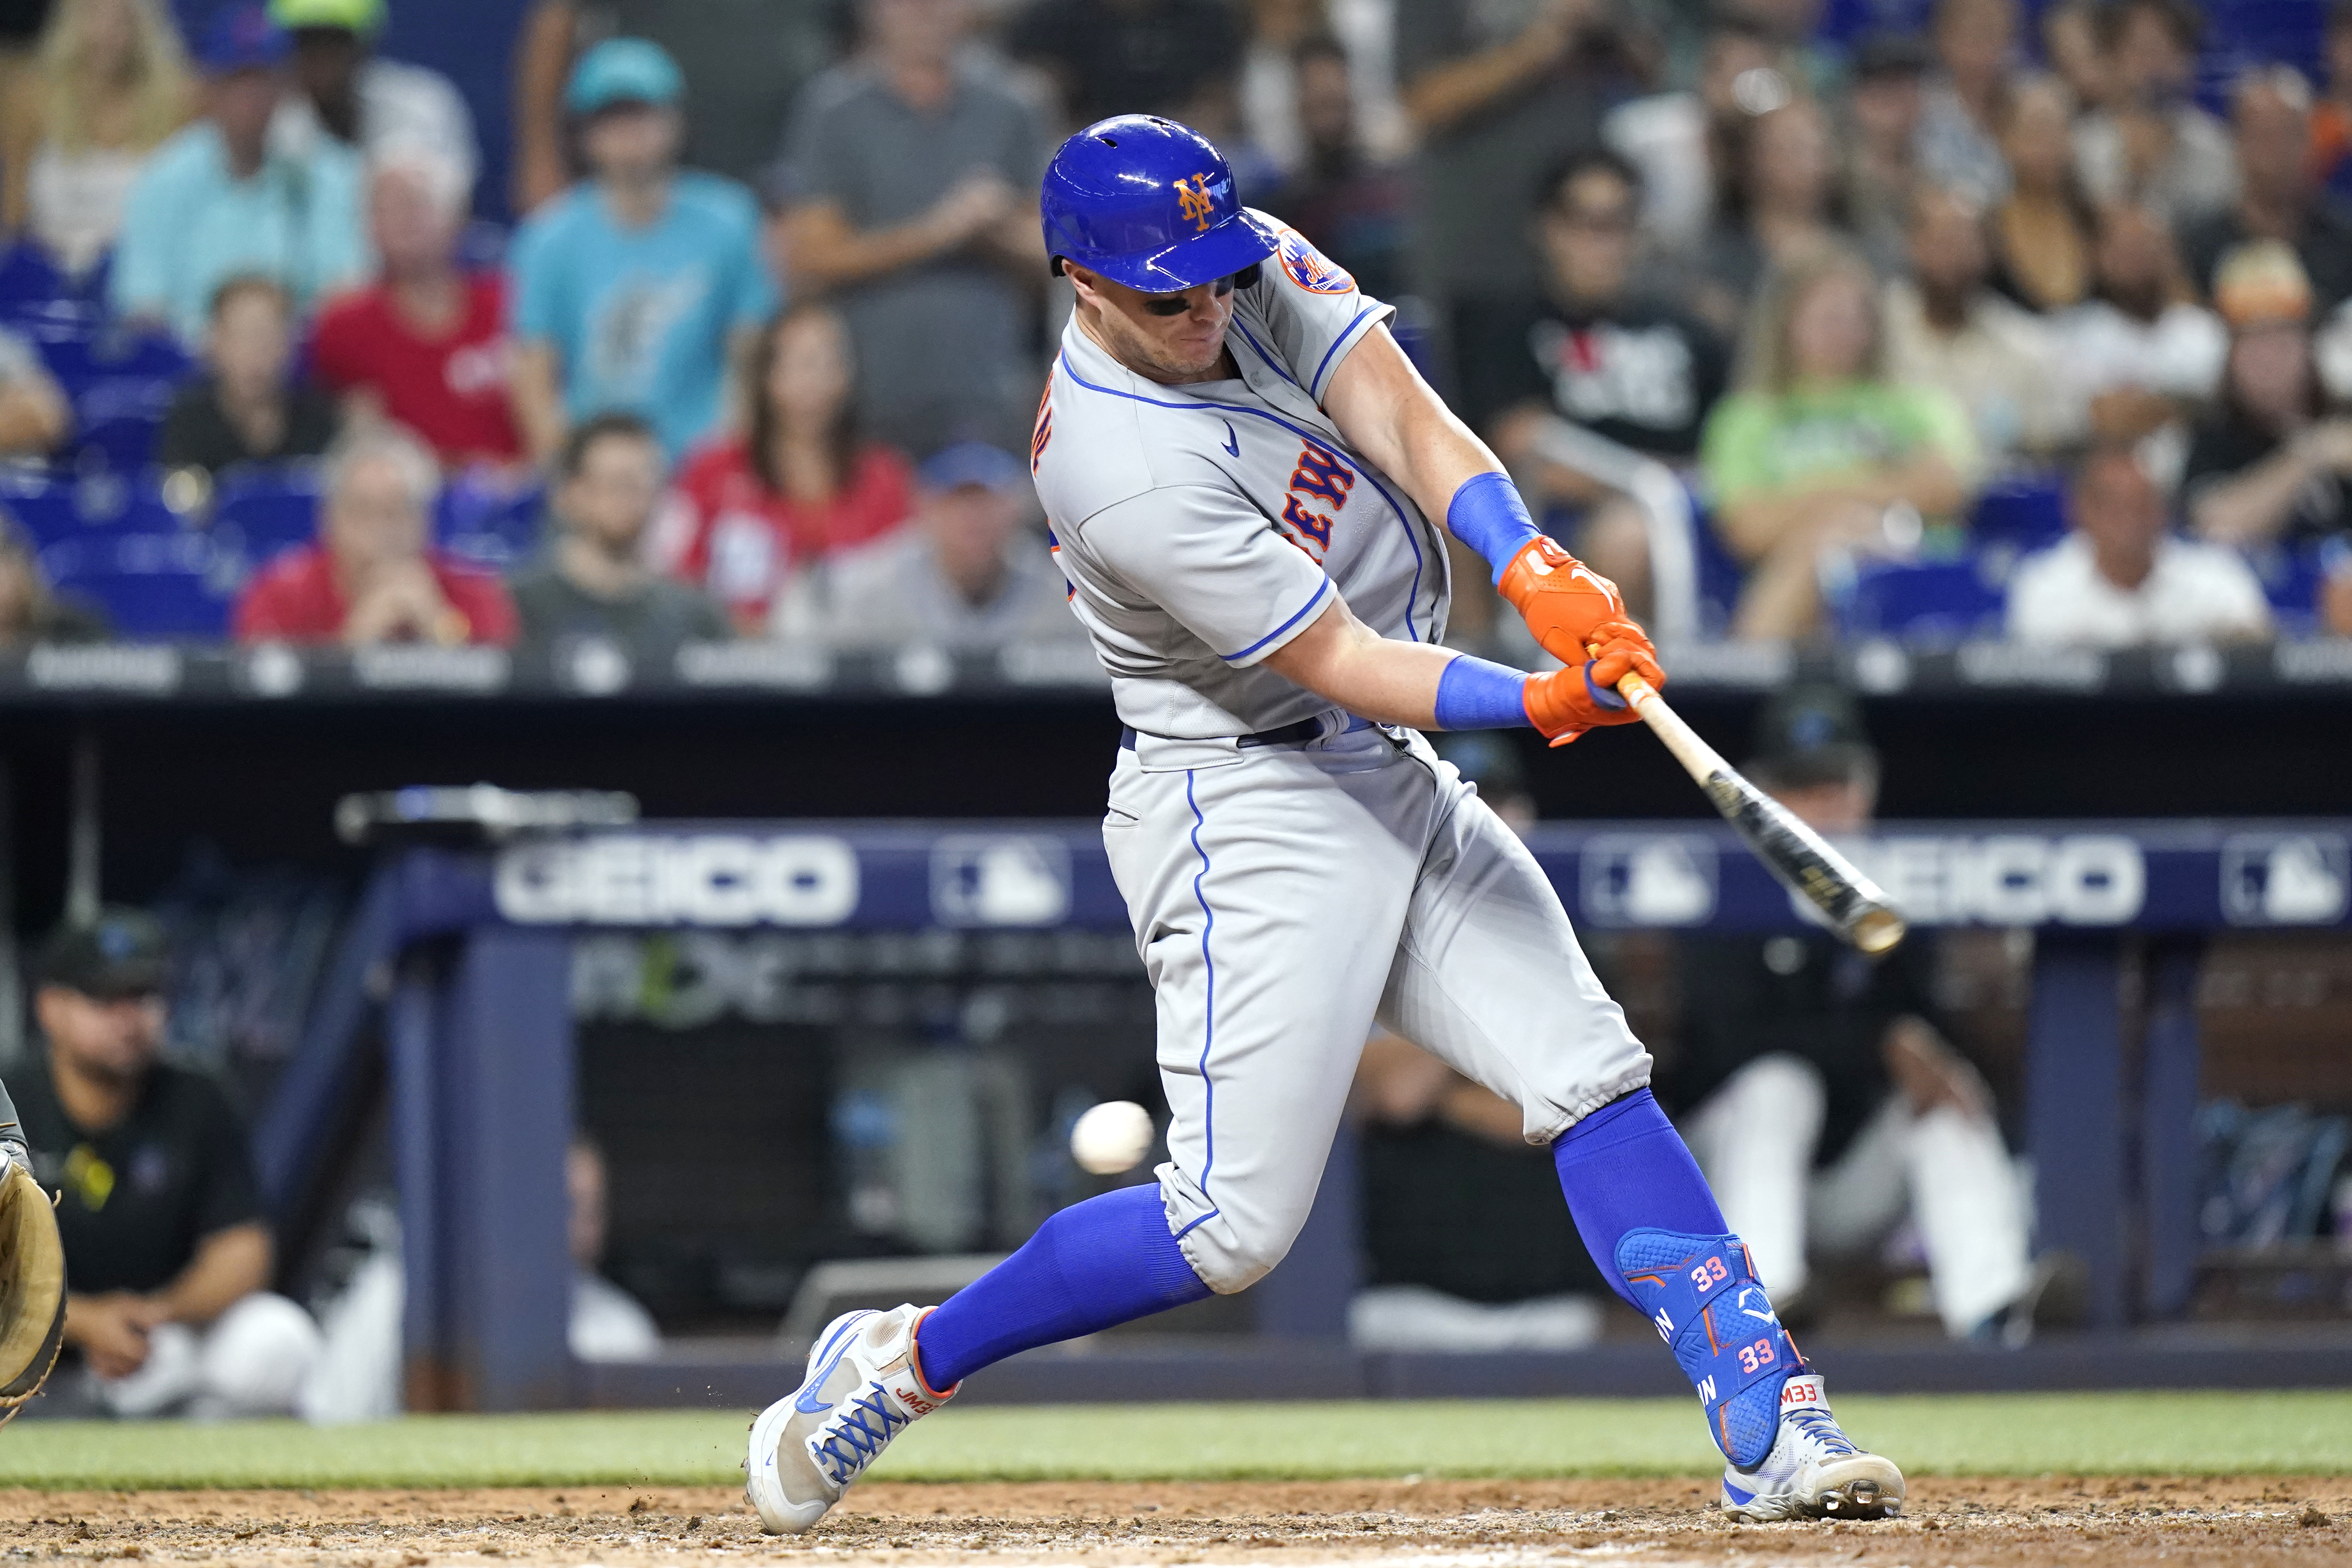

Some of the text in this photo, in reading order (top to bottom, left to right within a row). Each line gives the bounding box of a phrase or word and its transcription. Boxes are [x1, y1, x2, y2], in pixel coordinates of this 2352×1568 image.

[1301, 251, 1338, 284] Me
[1281, 439, 1355, 567] EW
[493, 834, 859, 926] GEICO
[1691, 1256, 1728, 1292] 33
[1738, 1339, 1775, 1374] 33
